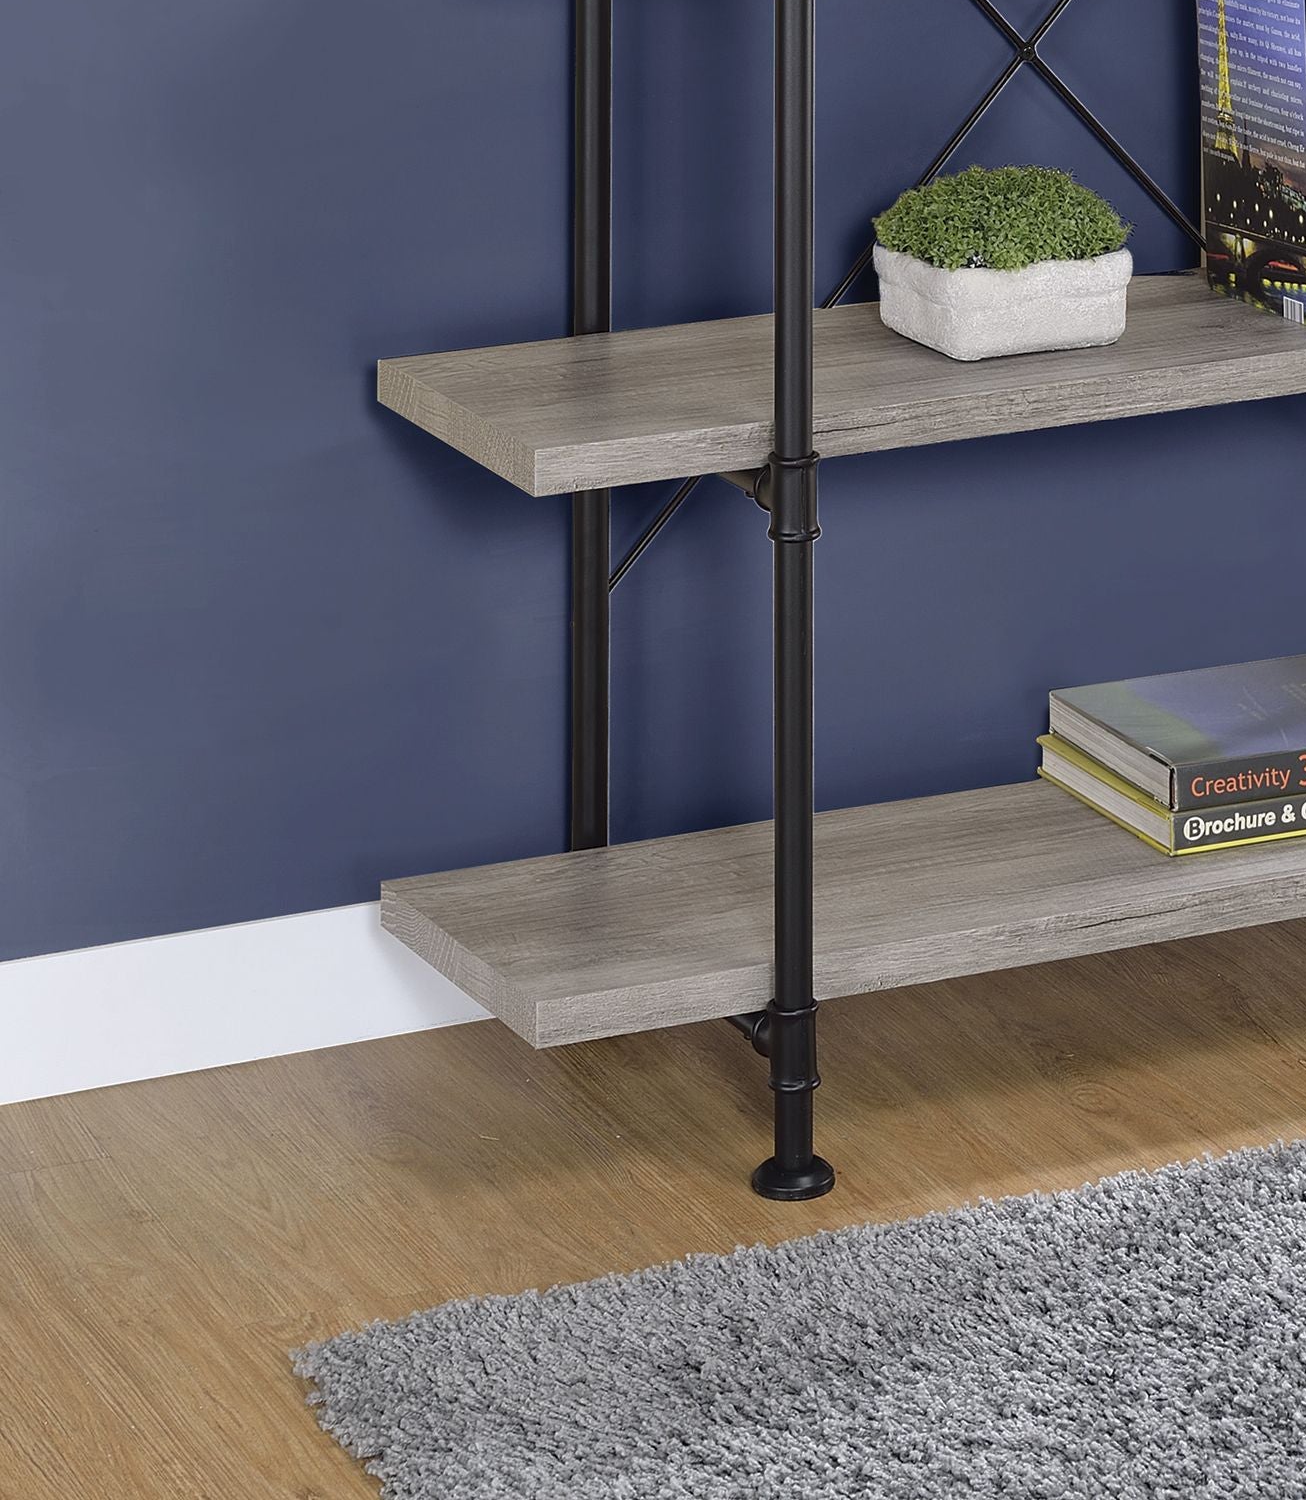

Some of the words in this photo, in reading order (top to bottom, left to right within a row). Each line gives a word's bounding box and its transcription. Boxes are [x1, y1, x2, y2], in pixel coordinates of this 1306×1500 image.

[1190, 767, 1291, 797] Creativity
[1183, 811, 1277, 842] Brochure
[1281, 803, 1296, 823] &
